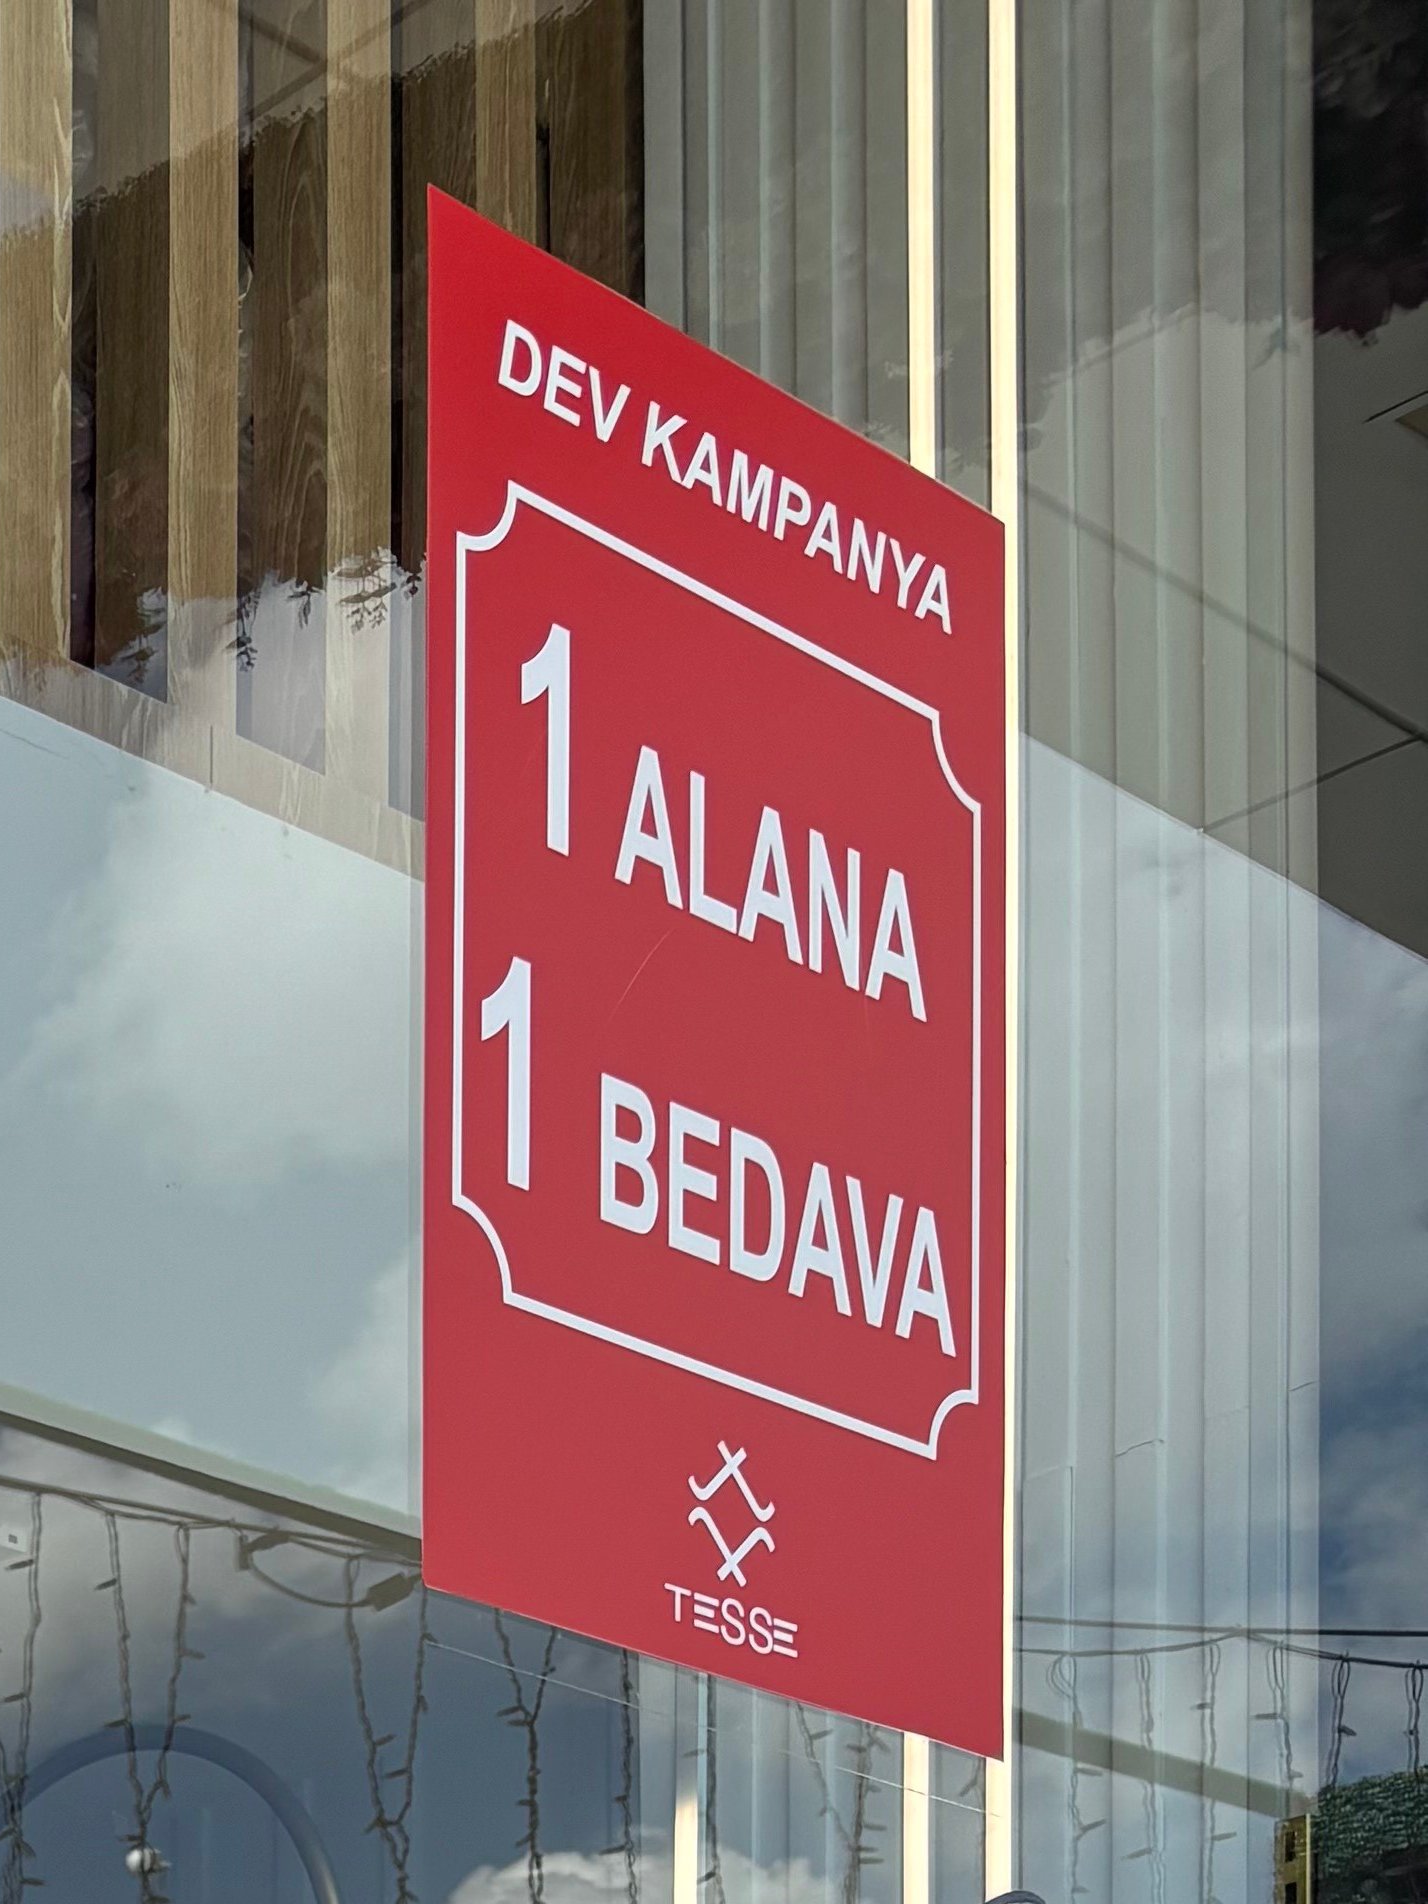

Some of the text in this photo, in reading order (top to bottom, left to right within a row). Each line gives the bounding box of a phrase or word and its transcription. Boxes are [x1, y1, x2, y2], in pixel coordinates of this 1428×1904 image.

[498, 319, 952, 635] DEV KAMPANYA
[521, 623, 927, 1023] 1 ALANA
[481, 956, 957, 1358] 1 BEDAVA
[663, 1582, 798, 1658] TESSE
